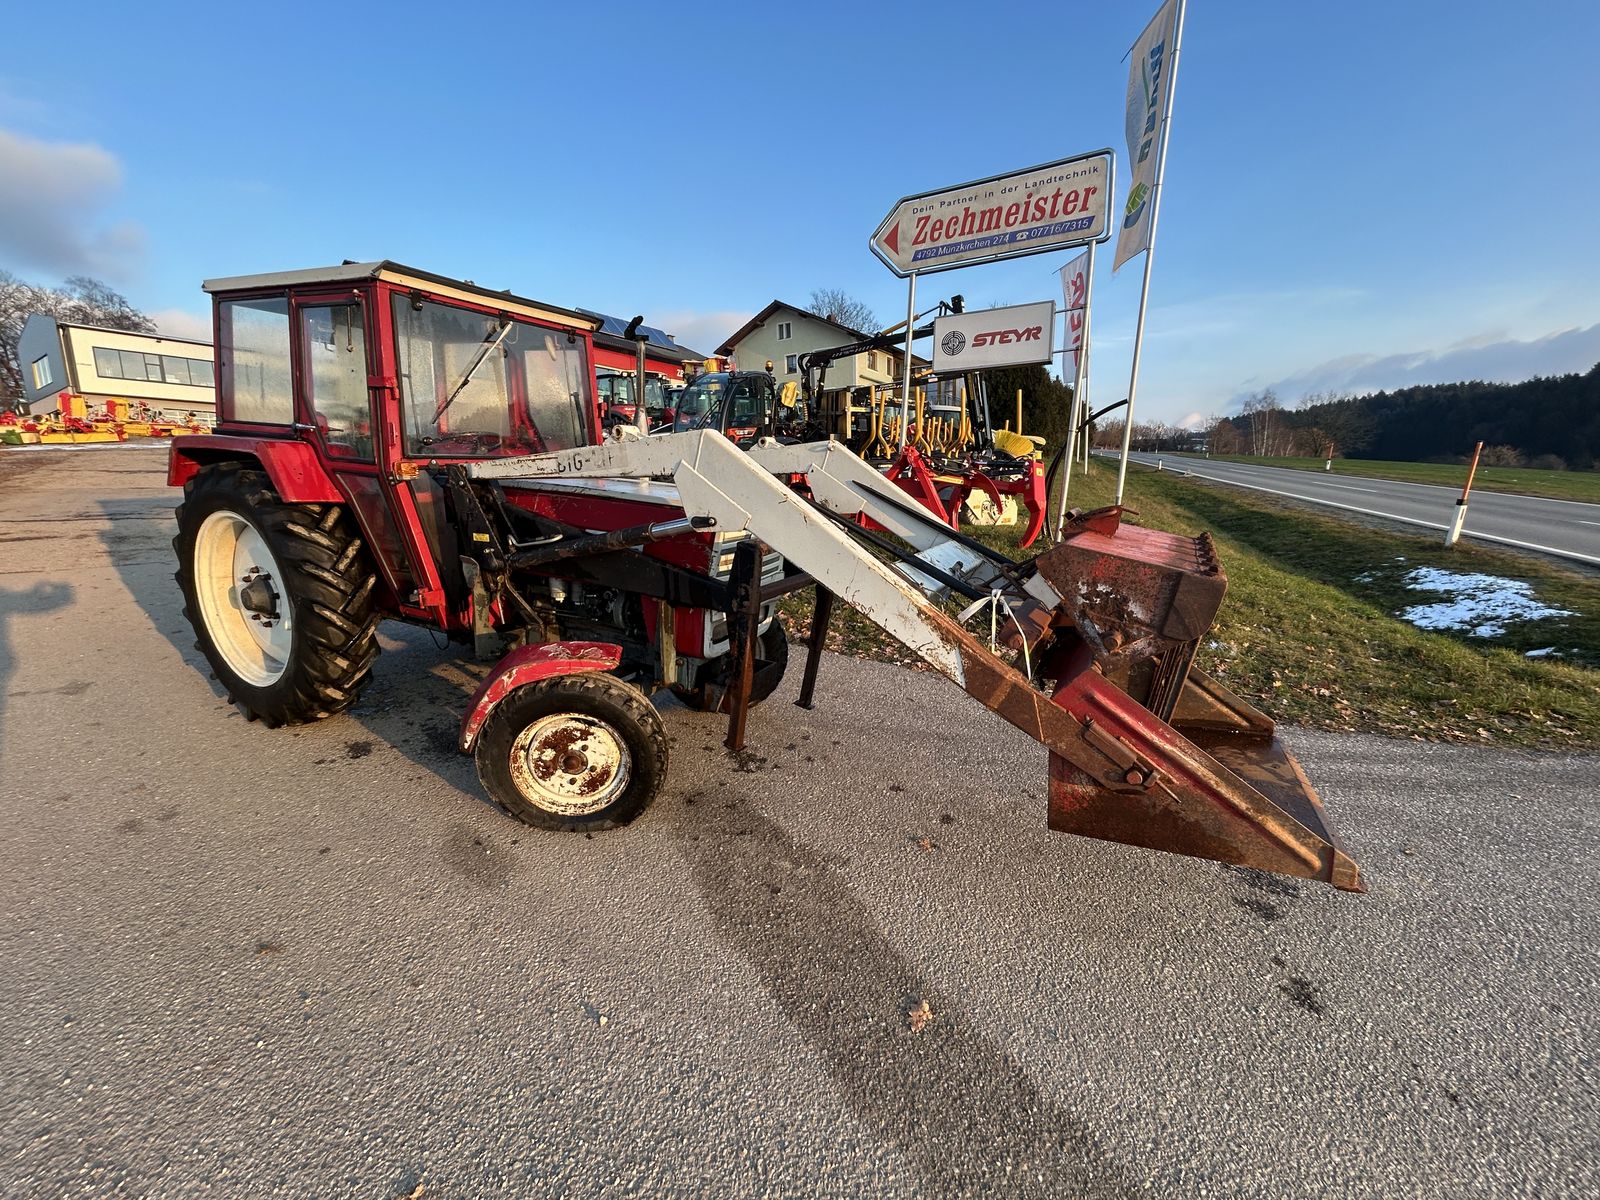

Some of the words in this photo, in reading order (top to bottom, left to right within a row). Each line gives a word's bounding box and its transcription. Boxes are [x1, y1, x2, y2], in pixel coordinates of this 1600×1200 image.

[912, 204, 934, 215] Dein
[940, 194, 978, 208] Partner
[1000, 185, 1018, 195] der
[1025, 166, 1099, 189] Landtechnik
[912, 185, 1098, 246] Zechmeister
[916, 248, 937, 259] 4792
[993, 234, 1010, 246] 274
[1031, 218, 1089, 238] 07716/7315
[971, 325, 1043, 348] STEYR
